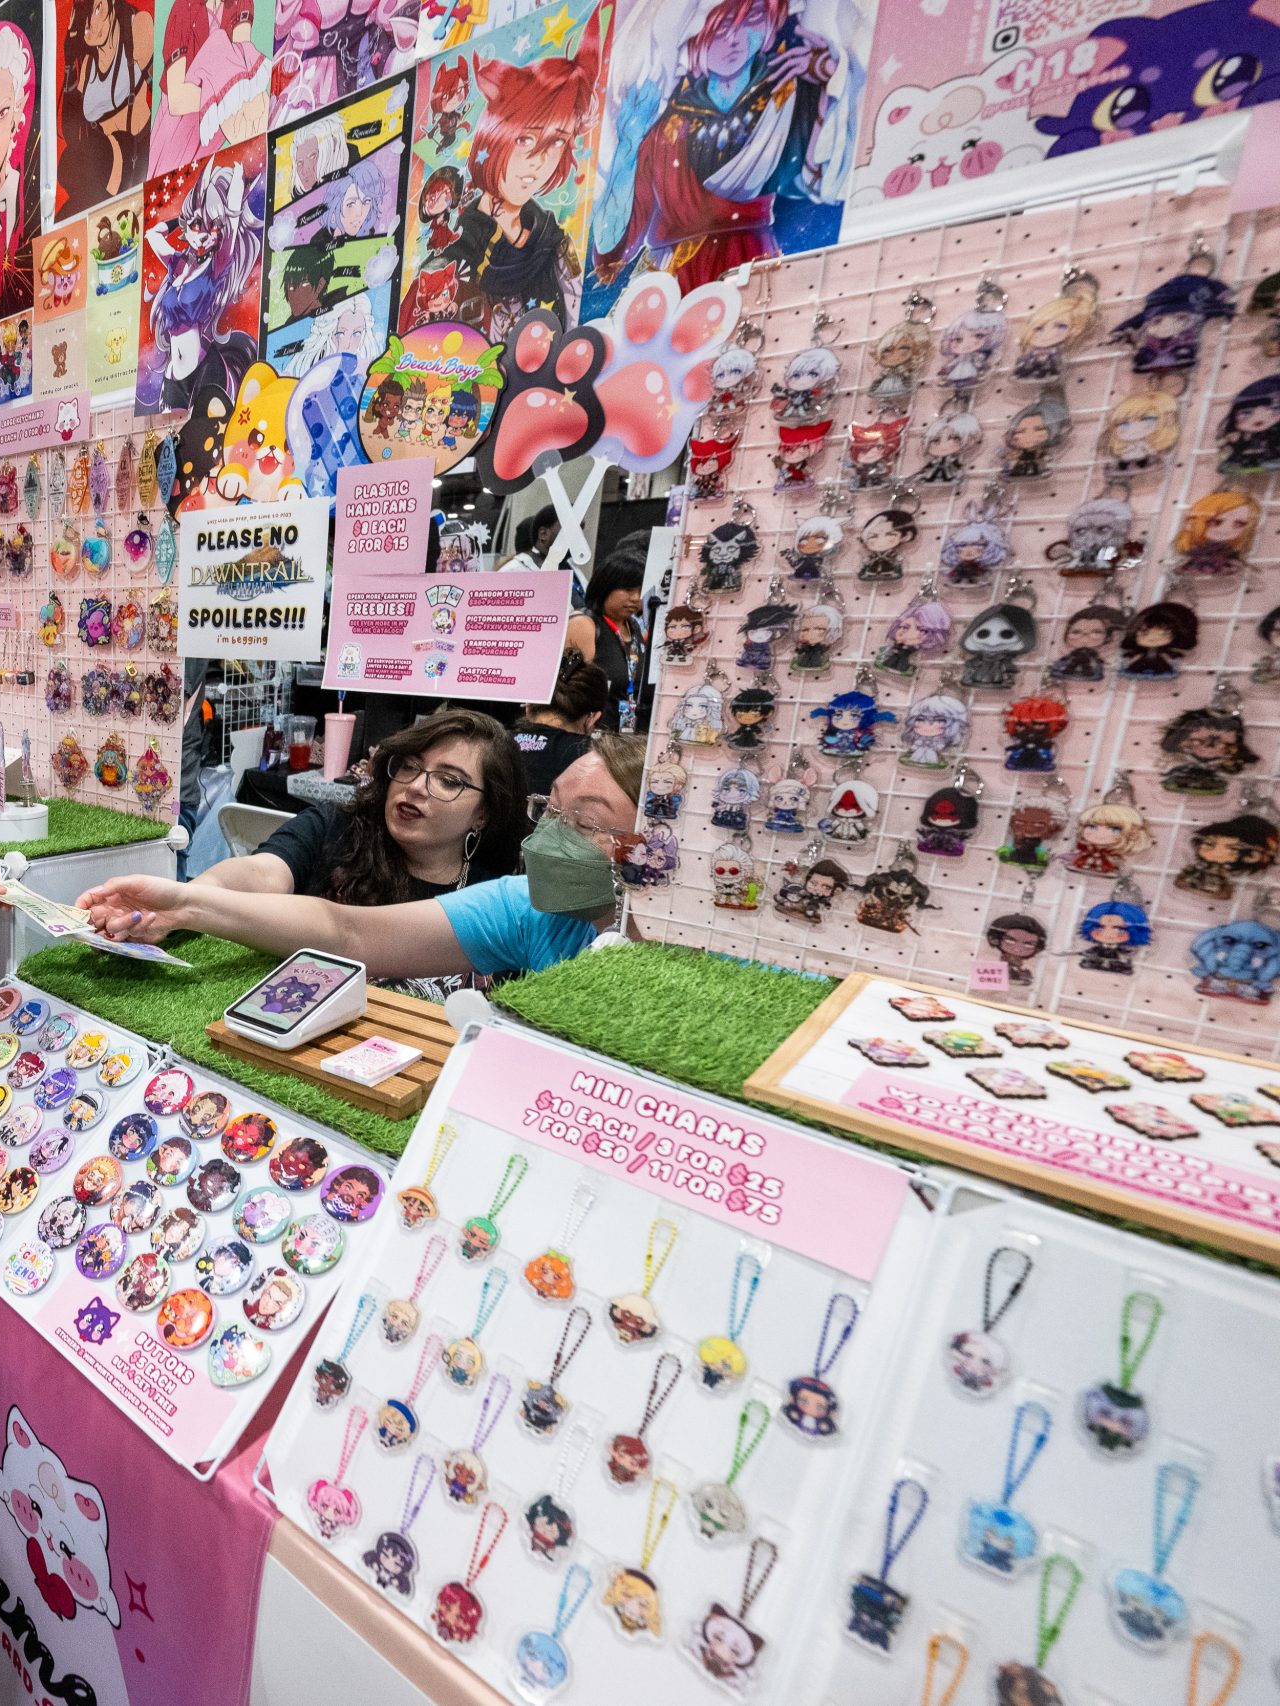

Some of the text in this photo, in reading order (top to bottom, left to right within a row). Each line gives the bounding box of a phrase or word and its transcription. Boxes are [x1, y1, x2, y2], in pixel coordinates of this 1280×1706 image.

[1013, 38, 1099, 93] H18
[395, 351, 483, 382] Beach Boys
[354, 480, 410, 500] PLASTIC
[346, 498, 417, 518] HAND FANS
[197, 524, 299, 551] PLEASE NO
[353, 518, 406, 537] $8 EACH
[348, 535, 409, 553] 2 FOR $15
[191, 559, 309, 585] DAWNTRAIL
[399, 592, 417, 600] MORE
[486, 598, 525, 606] PURCHASE
[504, 590, 534, 598] STICKER
[188, 607, 306, 629] SPOILERS!!!
[347, 602, 415, 617] FREEBIES!!
[466, 615, 515, 623] PICTOMANCER
[525, 615, 558, 623] STICKER
[483, 623, 503, 631] FFXIV
[503, 623, 541, 632] PURCHASE
[217, 634, 269, 646] i'm begging
[469, 640, 498, 648] RANDOM
[498, 641, 524, 649] RIBBON
[480, 648, 518, 656] PURCHASE
[459, 667, 502, 676] PLASTIC FAN
[479, 675, 516, 684] PURCHASE
[571, 1071, 766, 1157] MINI CHARMS
[886, 1085, 1037, 1138] WOODEN
[535, 1089, 575, 1118] $10
[574, 1106, 638, 1144] EACH
[655, 1138, 675, 1157] 3
[675, 1144, 726, 1178] FOR
[727, 1162, 784, 1199] $25
[1065, 1126, 1214, 1172] MINION
[522, 1108, 540, 1126] 7
[538, 1116, 582, 1145] FOR
[582, 1132, 629, 1164] $50
[648, 1159, 673, 1182] 11
[673, 1169, 725, 1203] FOR
[726, 1188, 783, 1226] $75
[945, 1115, 1048, 1153] EACH
[1122, 1164, 1209, 1198] FOR
[22, 1250, 41, 1267] GAY
[8, 1254, 39, 1288] AGENDA
[134, 1330, 195, 1386] BUTTONS
[54, 1327, 82, 1353] STICKERS
[82, 1351, 96, 1367] MINI
[93, 1361, 114, 1383] PRINTS
[111, 1377, 141, 1408] INCLUDED
[137, 1401, 148, 1413] IN
[129, 1350, 177, 1396] $5 EACH
[111, 1354, 130, 1375] BUY
[126, 1366, 137, 1381] 4
[133, 1374, 153, 1392] GET
[153, 1393, 178, 1417] FREE!
